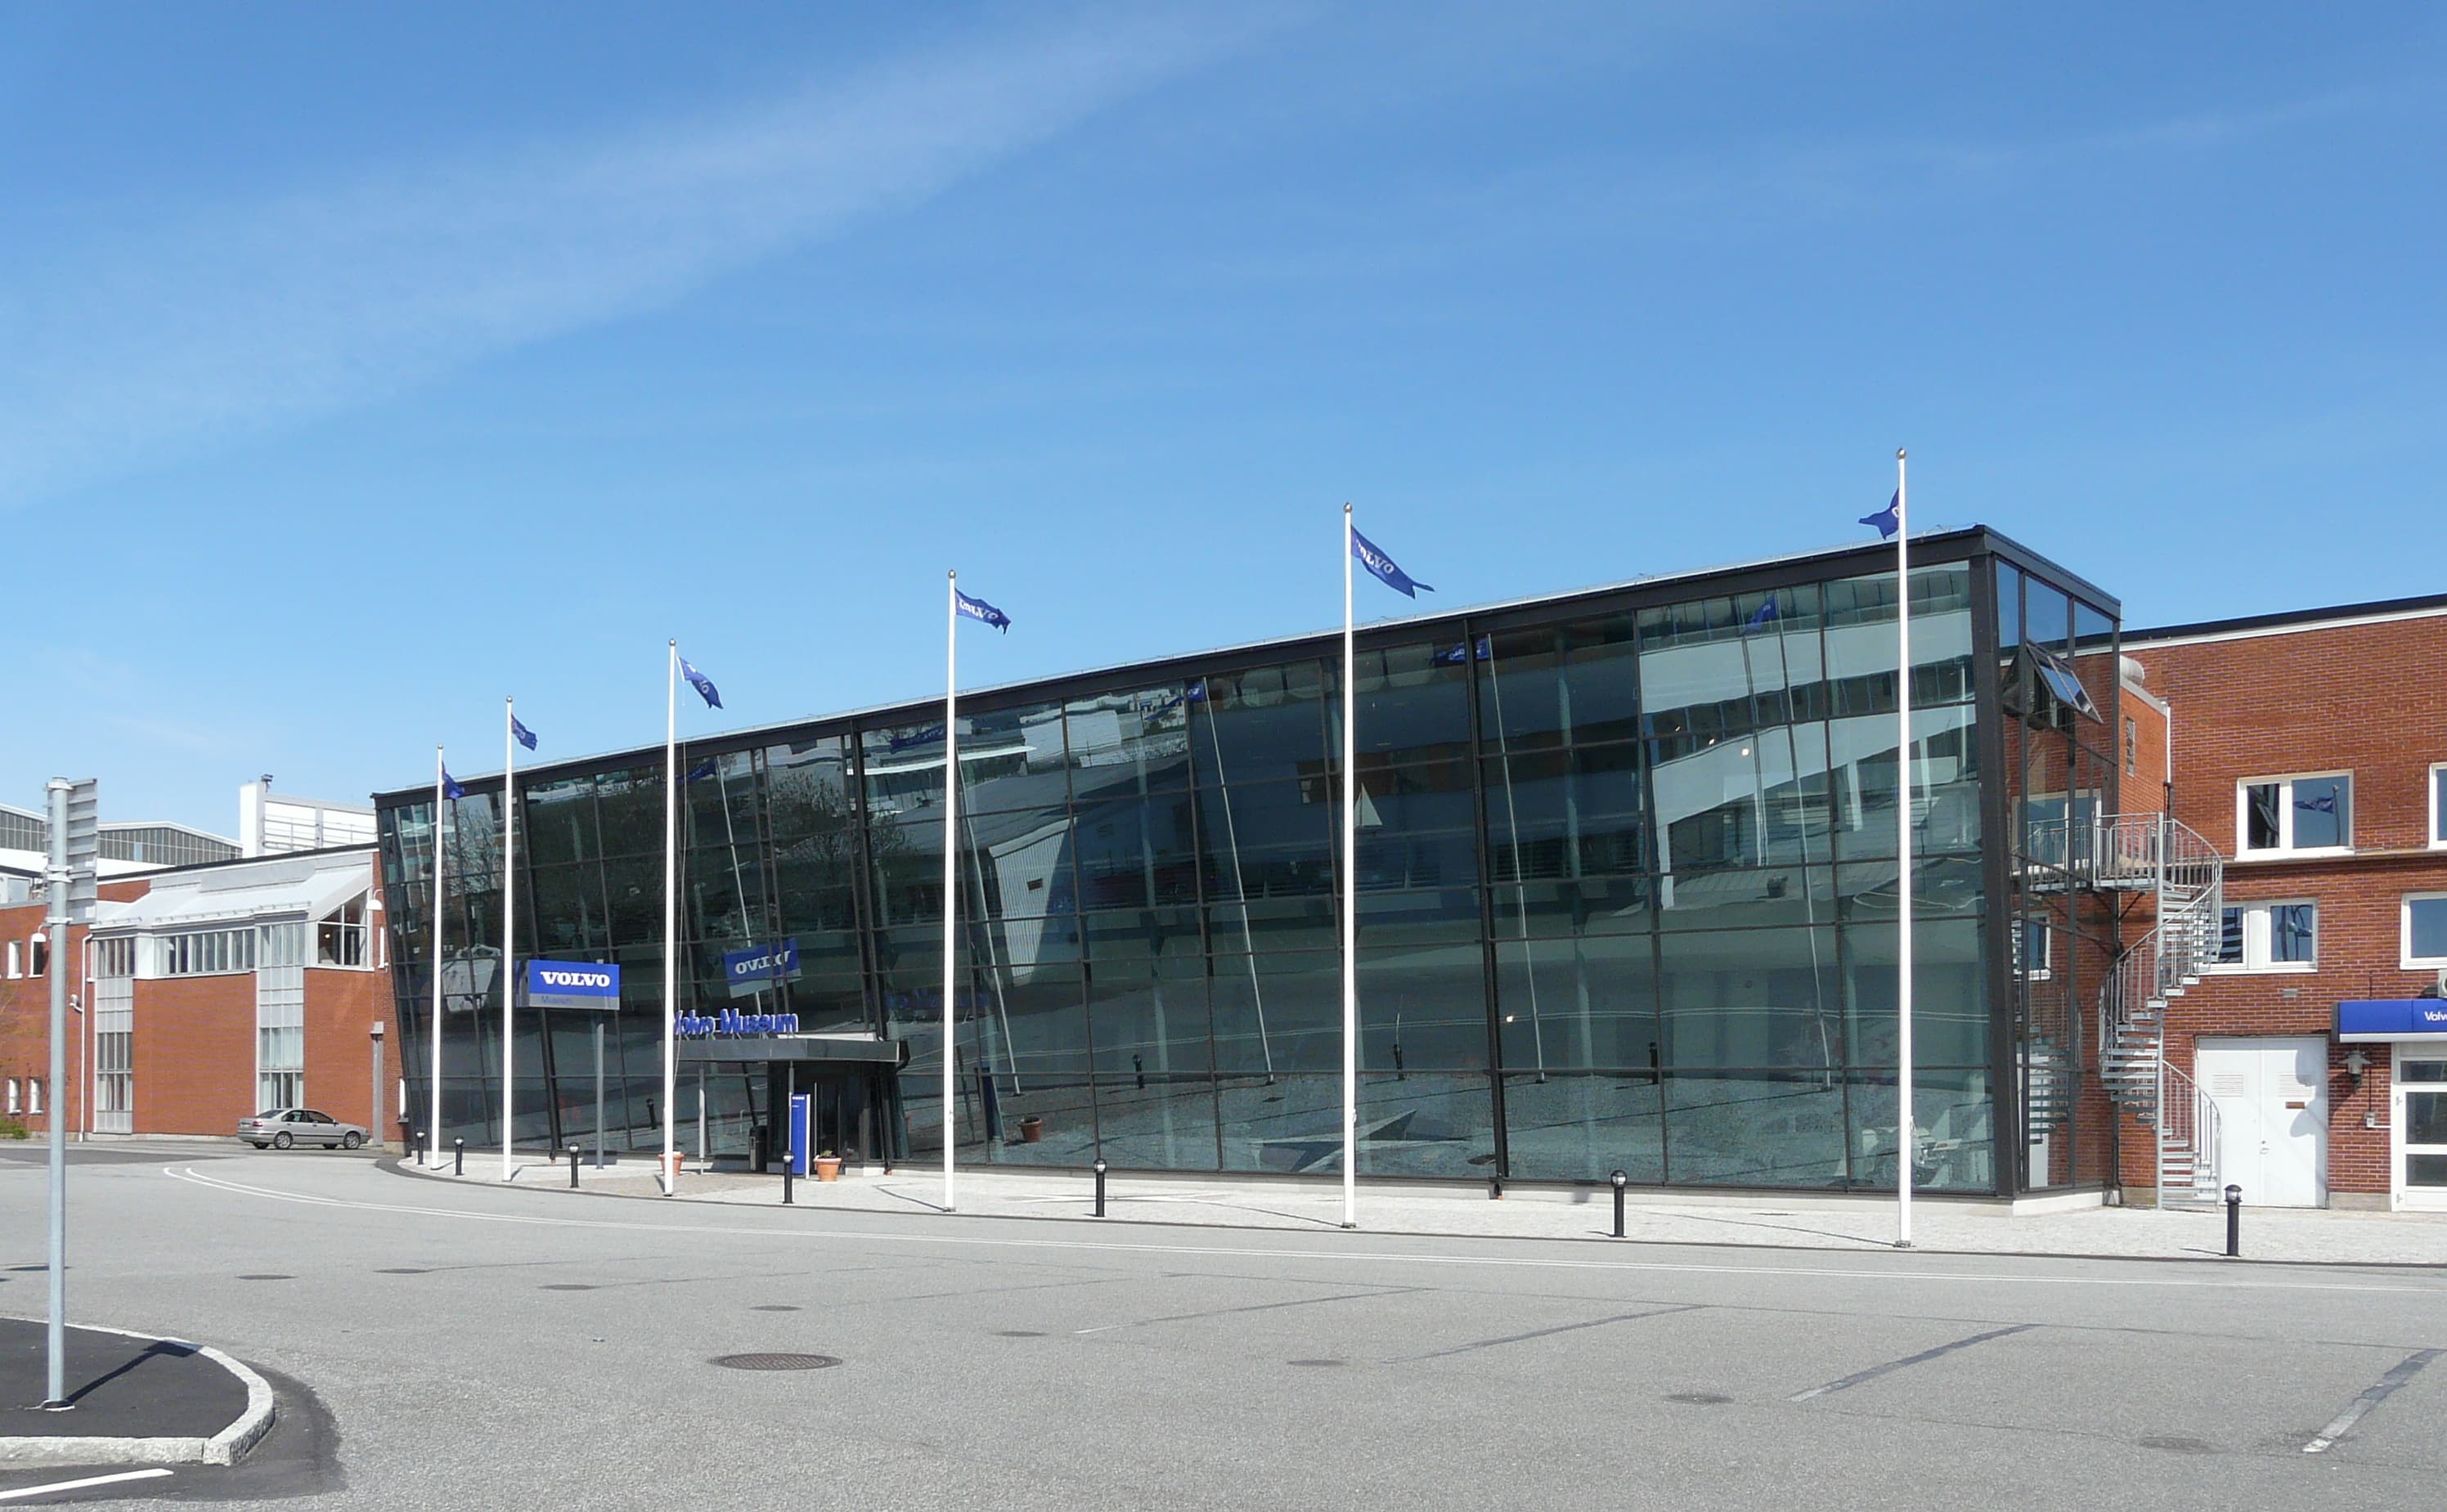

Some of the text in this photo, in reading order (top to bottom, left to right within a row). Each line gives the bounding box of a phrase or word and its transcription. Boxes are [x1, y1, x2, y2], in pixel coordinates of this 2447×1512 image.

[540, 971, 610, 987] VOLVO
[720, 1007, 799, 1034] Museum
[2424, 1011, 2447, 1021] Volv
